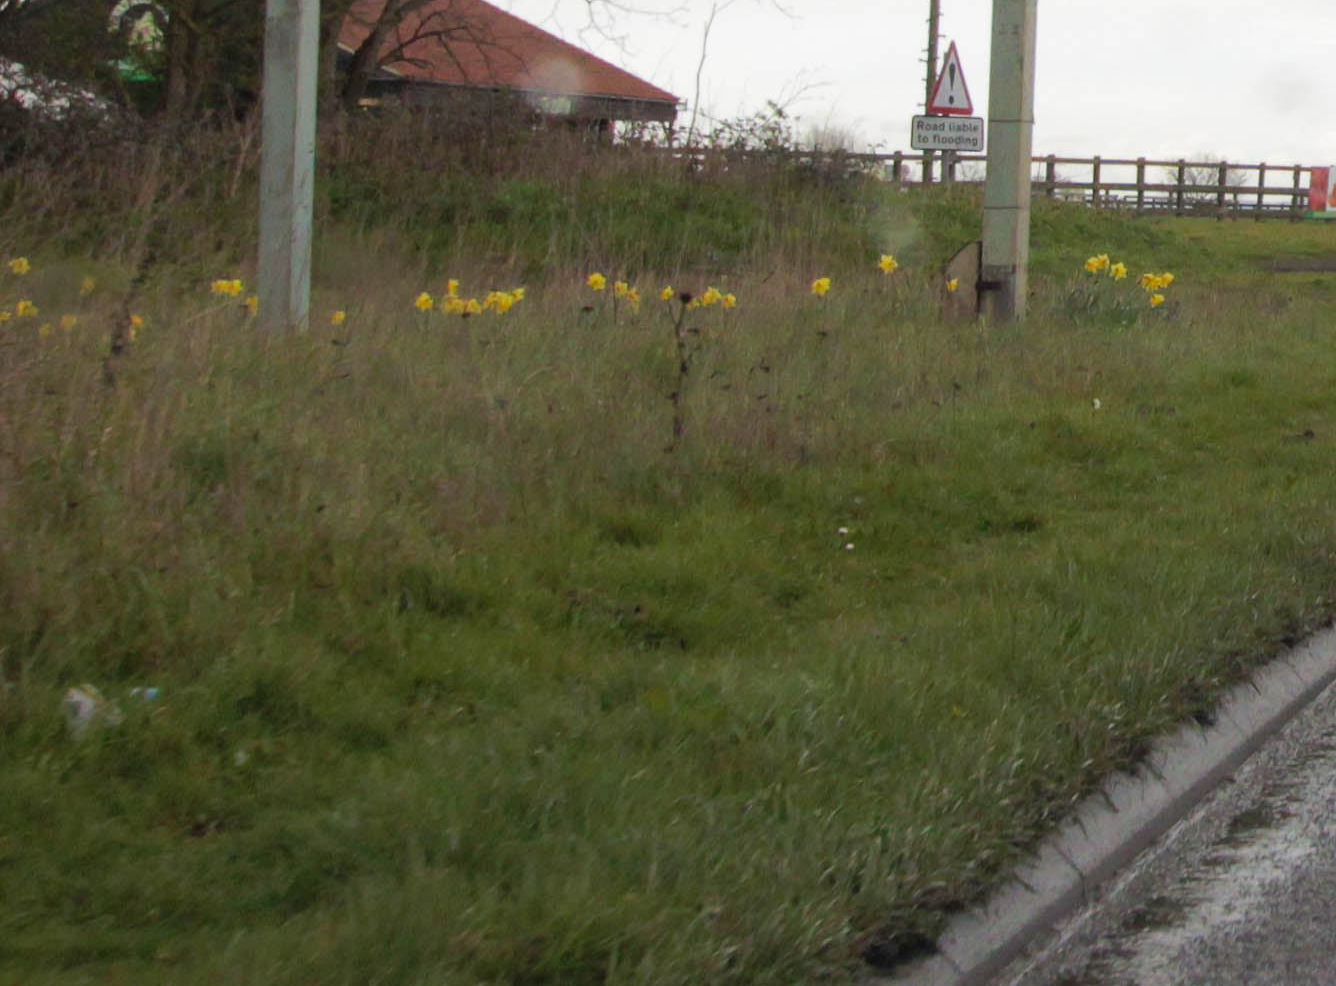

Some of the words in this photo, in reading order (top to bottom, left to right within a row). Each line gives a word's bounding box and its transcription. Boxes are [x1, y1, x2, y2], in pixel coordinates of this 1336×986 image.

[916, 120, 945, 132] Road
[948, 122, 979, 133] liable
[917, 134, 929, 143] to
[933, 134, 978, 146] flooding
